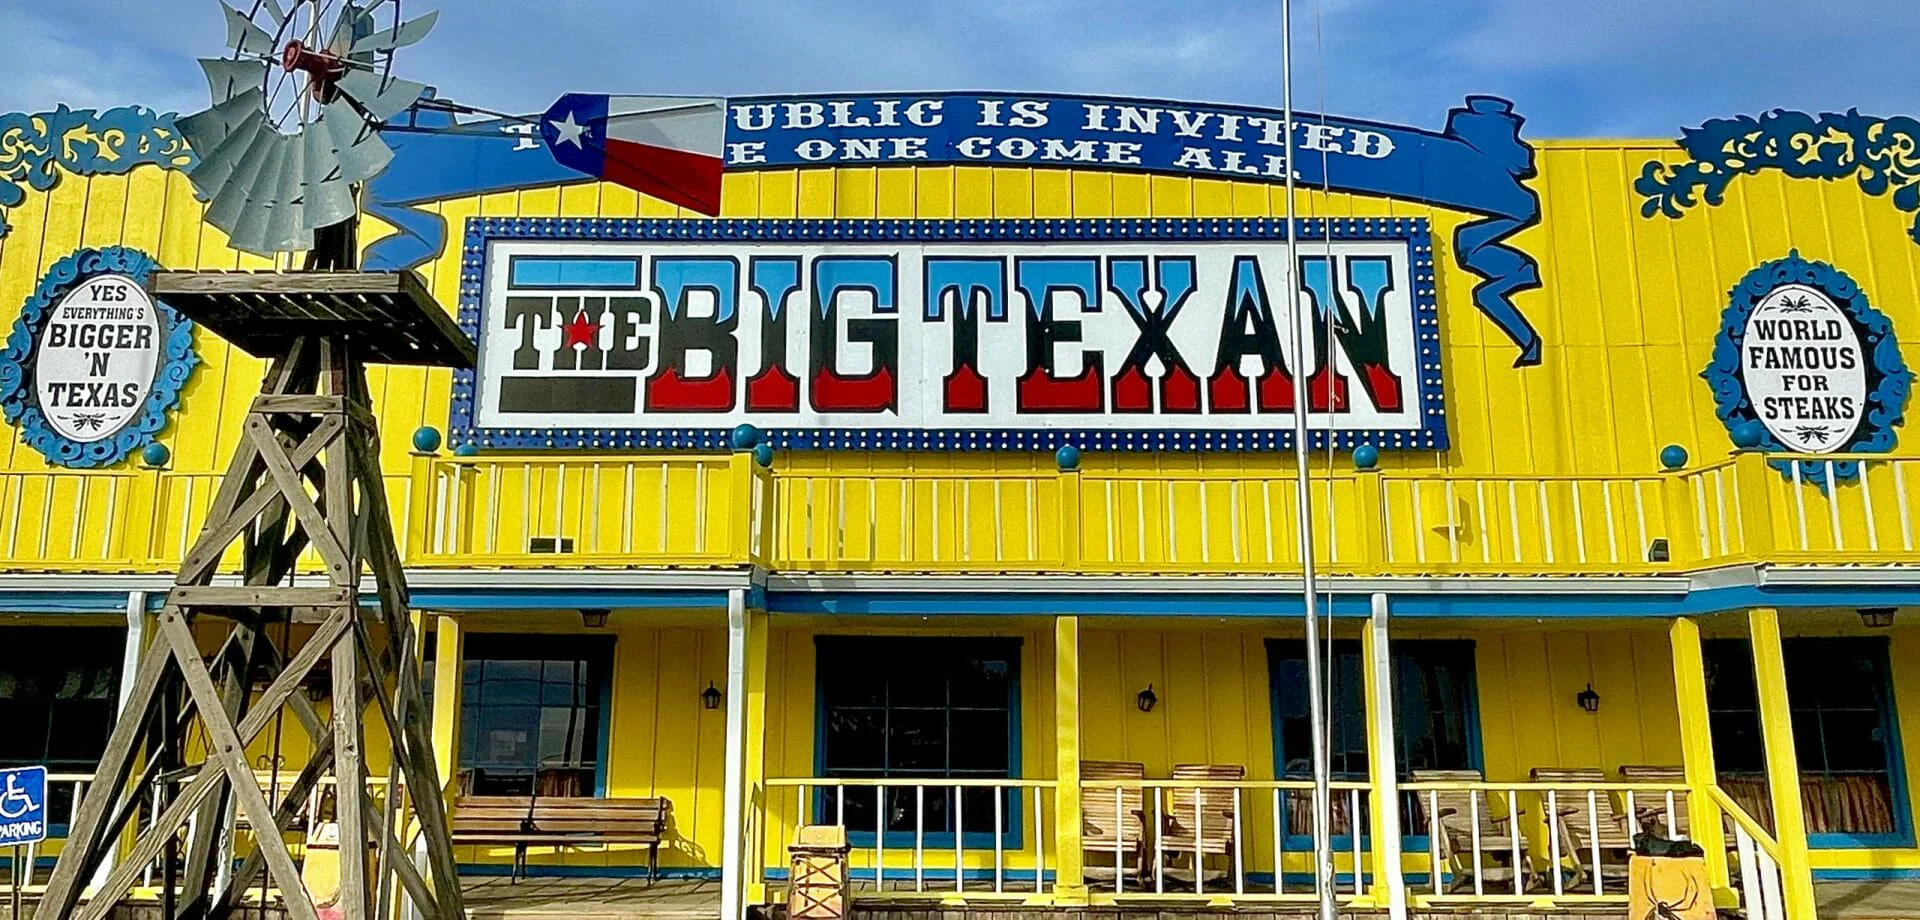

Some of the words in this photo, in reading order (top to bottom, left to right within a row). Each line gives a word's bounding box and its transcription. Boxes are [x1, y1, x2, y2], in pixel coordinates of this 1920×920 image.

[731, 100, 945, 132] UBLIC
[976, 100, 1050, 128] IS
[1082, 104, 1396, 160] INVITED
[795, 138, 930, 161] ONE
[958, 137, 1143, 165] COME
[90, 285, 127, 301] YES
[62, 307, 145, 320] EVERYTHING'S
[48, 324, 152, 349] BIGGER
[504, 297, 652, 370] THE
[643, 252, 899, 416] BIG
[922, 254, 1404, 415] TEXAN
[1753, 319, 1842, 341] WORLD
[84, 352, 110, 377] 'N
[1749, 346, 1856, 370] FAMOUS
[48, 382, 139, 408] TEXAS
[1781, 375, 1829, 391] FOR
[1763, 396, 1855, 420] STEAKS
